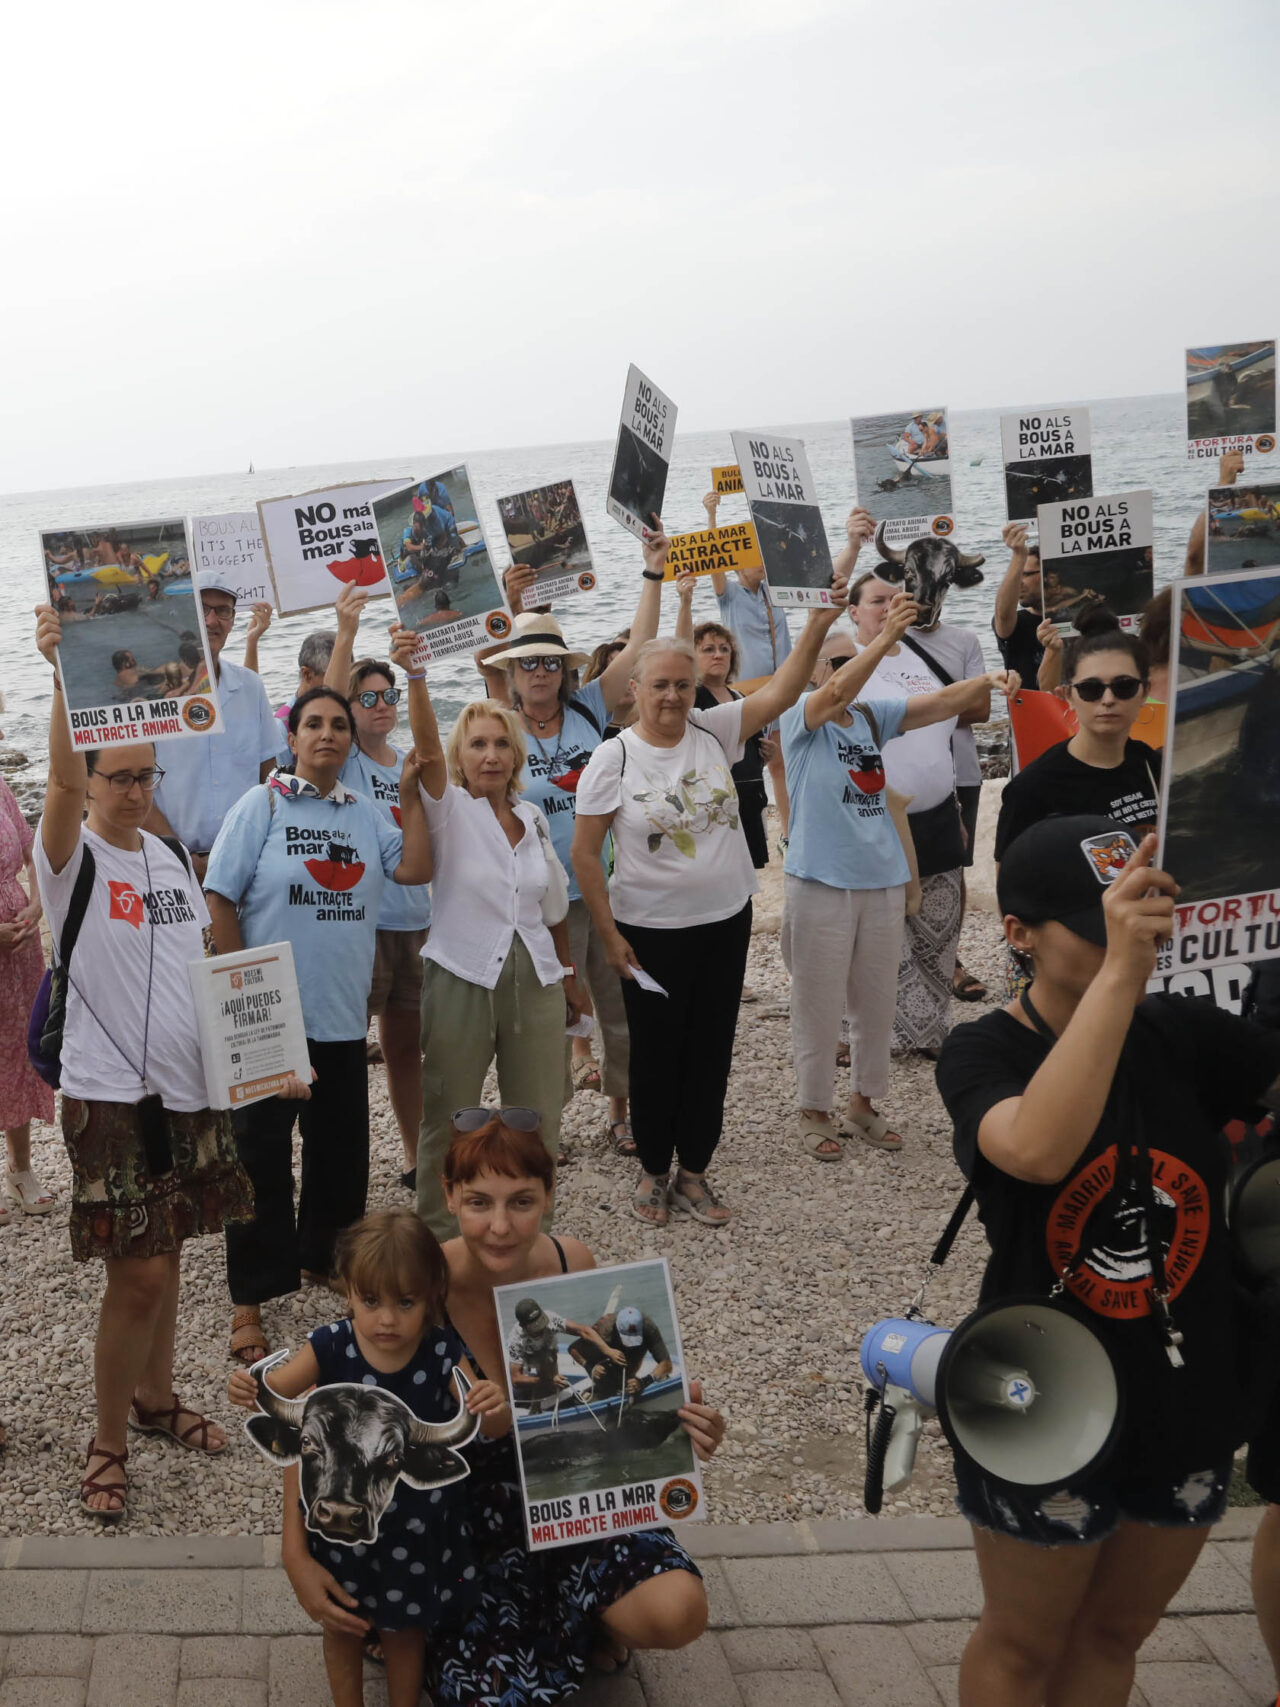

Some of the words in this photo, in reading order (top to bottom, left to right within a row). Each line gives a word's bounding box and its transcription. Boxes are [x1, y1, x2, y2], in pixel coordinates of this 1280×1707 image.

[638, 381, 651, 403] NO
[653, 398, 667, 418] ALS
[635, 397, 658, 429] BOUS
[659, 423, 665, 437] A
[1019, 417, 1041, 431] NO
[1046, 416, 1071, 428] ALS
[632, 415, 641, 434] LA
[643, 426, 663, 451] MAR
[1019, 430, 1061, 445] BOUS
[1065, 430, 1074, 440] A
[1194, 435, 1254, 448] TORTURA
[749, 440, 769, 459] NO
[773, 446, 794, 462] ALS
[1019, 447, 1036, 459] LA
[1040, 442, 1074, 456] MAR
[753, 461, 790, 480] BOUS
[793, 467, 800, 481] A
[758, 482, 775, 497] LA
[775, 482, 806, 501] MAR
[295, 503, 336, 528] NO
[1062, 505, 1090, 522] NO
[1095, 502, 1129, 518] ALS
[199, 520, 235, 536] BOUS
[298, 525, 354, 546] Bous
[363, 521, 374, 530] la
[689, 536, 697, 545] A
[700, 532, 715, 543] LA
[718, 526, 746, 539] MAR
[1061, 518, 1115, 538] BOUS
[1120, 518, 1131, 531] A
[201, 540, 225, 552] IT'S
[235, 538, 263, 551] THE
[303, 541, 345, 561] mar
[1061, 540, 1082, 554] LA
[1087, 532, 1132, 550] MAR
[201, 553, 254, 567] BIGGEST
[673, 555, 738, 576] ANIMAL
[426, 626, 456, 640] MALTRATO
[457, 618, 480, 631] ANIMAL
[413, 653, 431, 665] STOP
[433, 635, 489, 658] TIERMISSHANDLUNG
[430, 637, 452, 650] ANIMAL
[454, 630, 474, 641] ABUSE
[71, 709, 108, 729] BOUS
[113, 707, 122, 723] A
[127, 704, 145, 722] LA
[149, 700, 179, 719] MAR
[74, 723, 138, 746] MALTRACTE
[141, 718, 182, 737] ANIMAL
[285, 826, 331, 841] Bous
[287, 842, 324, 855] mar
[316, 905, 365, 921] animal
[1181, 921, 1280, 964] CULTU
[1157, 955, 1172, 971] ES
[221, 993, 245, 1017] ¡AQUÍ
[246, 989, 281, 1010] PUEDES
[233, 1007, 272, 1029] FIRMAR!
[1056, 1165, 1111, 1231] MADRID
[1171, 1173, 1204, 1217] SAVE
[1101, 1288, 1138, 1309] SAVE
[529, 1500, 571, 1524] BOUS
[579, 1496, 590, 1515] A
[597, 1491, 616, 1513] LA
[622, 1483, 656, 1508] MAR
[531, 1515, 607, 1544] MALTRACTE
[612, 1505, 658, 1529] ANIMAL
